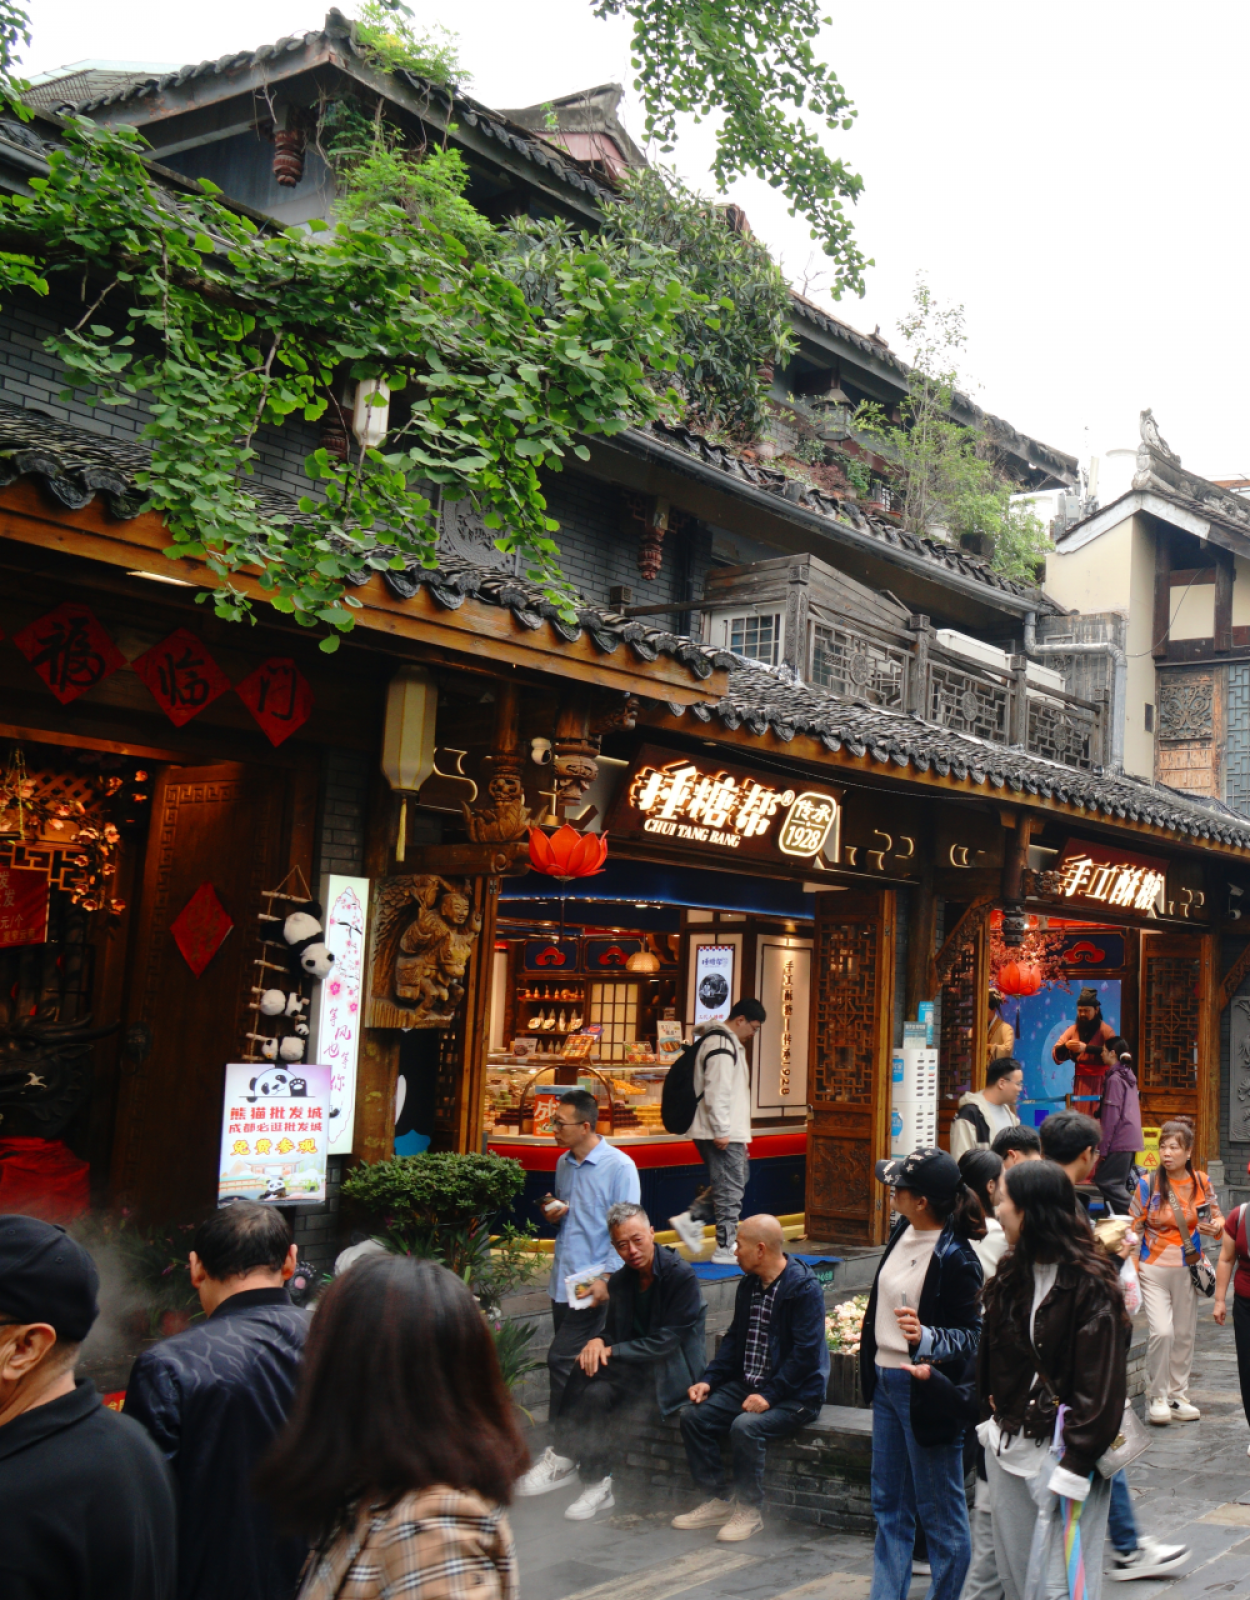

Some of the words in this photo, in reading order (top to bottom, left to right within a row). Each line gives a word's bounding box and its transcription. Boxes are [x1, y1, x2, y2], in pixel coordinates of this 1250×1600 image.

[793, 799, 832, 823] 传承
[644, 819, 676, 836] CHUI
[677, 825, 709, 842] TANG
[709, 830, 741, 848] BANG
[786, 825, 821, 850] 1928
[1063, 857, 1165, 911] 手工酥糖
[230, 1106, 323, 1121] 熊猫批发城
[229, 1122, 323, 1134] 成都必逛批发城
[230, 1136, 318, 1156] 免费参观
